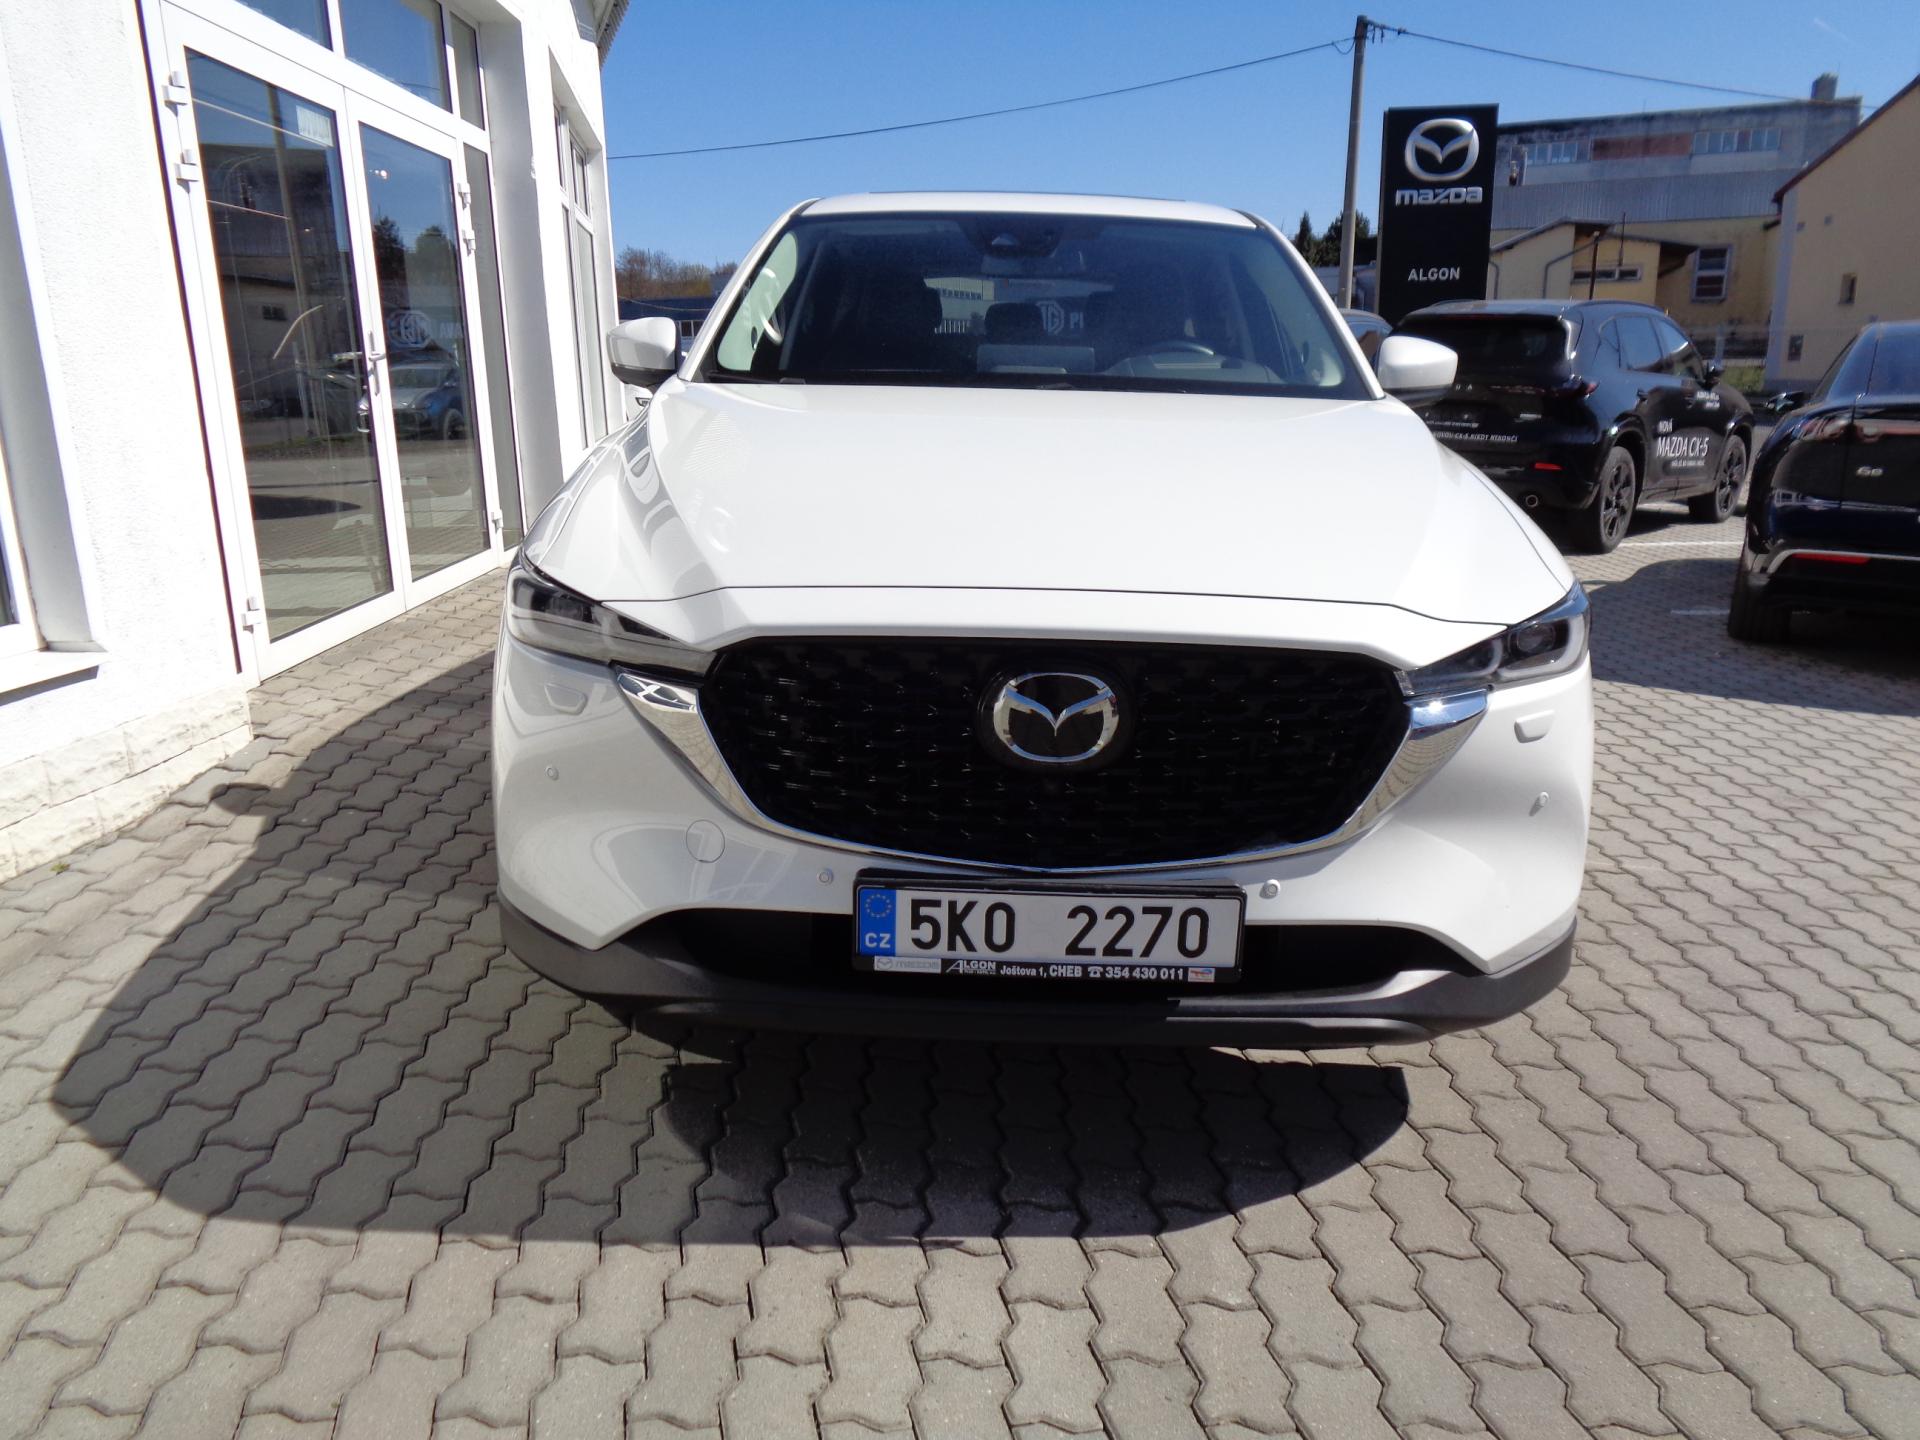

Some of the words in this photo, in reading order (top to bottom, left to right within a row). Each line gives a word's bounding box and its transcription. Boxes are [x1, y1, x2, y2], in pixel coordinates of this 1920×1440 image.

[1408, 267, 1460, 281] ALGON
[1657, 436, 1689, 457] MAZDA
[1689, 437, 1710, 457] CX-5
[1064, 905, 1210, 958] 2270
[865, 932, 891, 949] CZ
[946, 960, 996, 974] ALGON
[1000, 965, 1037, 976] Joštova
[1049, 965, 1083, 978] CHEB
[1105, 967, 1129, 979] 354
[1133, 968, 1157, 980] 430
[1160, 968, 1184, 980] 011
